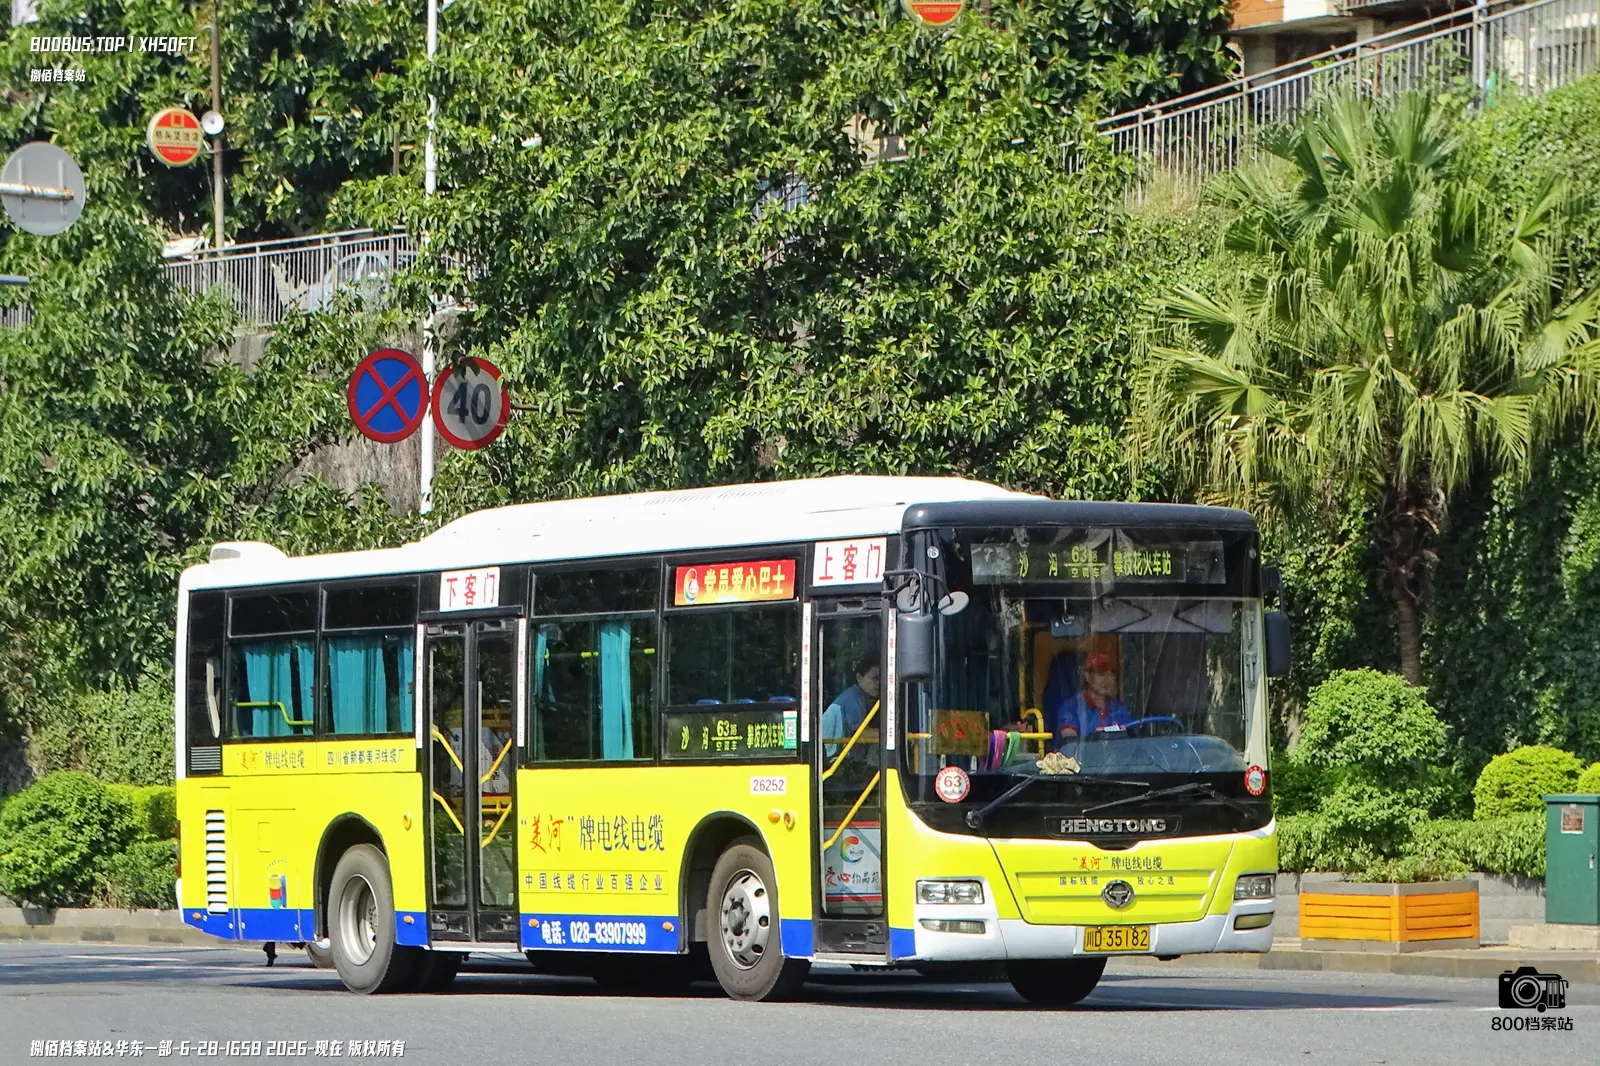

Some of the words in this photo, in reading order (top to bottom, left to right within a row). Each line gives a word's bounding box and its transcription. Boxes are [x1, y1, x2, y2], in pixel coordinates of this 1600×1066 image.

[447, 382, 492, 425] 40
[818, 543, 881, 581] 上客门
[703, 564, 786, 595] 党员爱心巴士
[446, 573, 496, 608] 下客门
[752, 779, 785, 792] 26252
[944, 775, 962, 788] 63
[1060, 818, 1167, 834] HENGTONG
[525, 873, 663, 892] 中国线缆行业百强企业
[1059, 876, 1098, 885] 国标线缆
[1137, 876, 1175, 885] 放心之选
